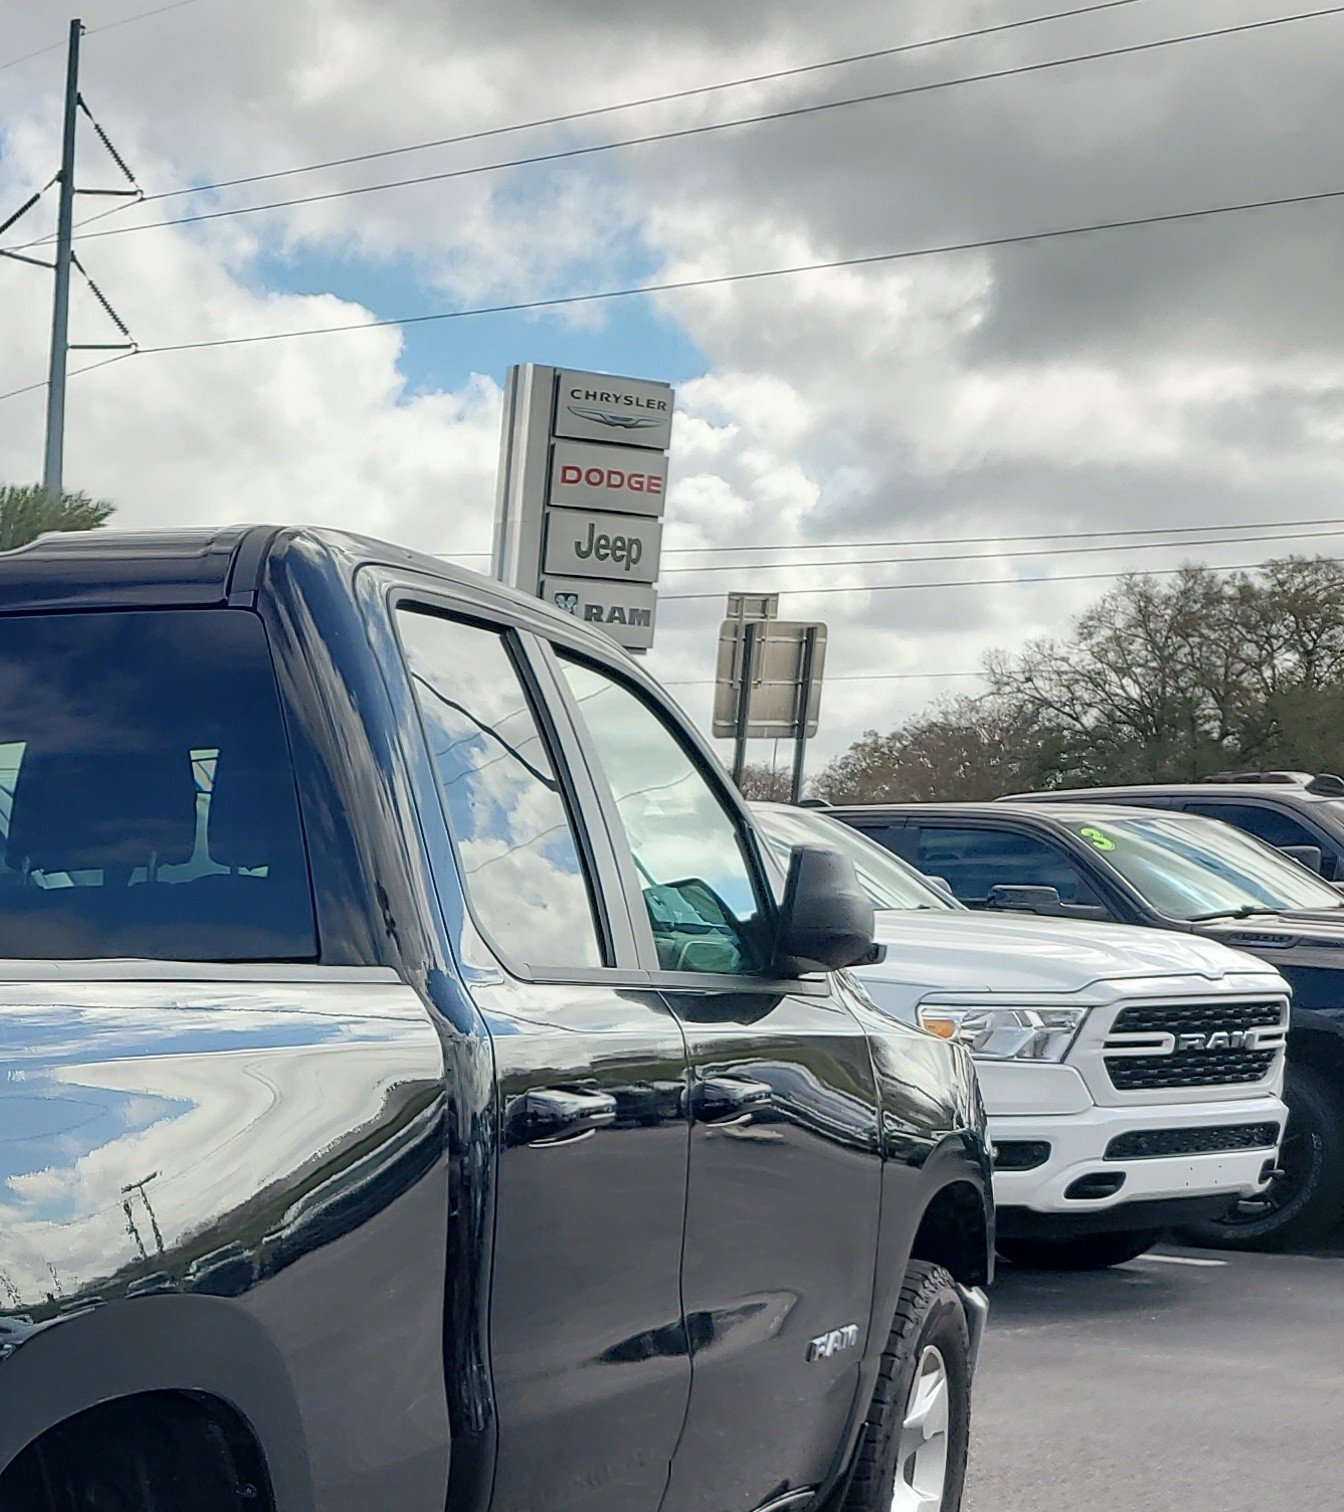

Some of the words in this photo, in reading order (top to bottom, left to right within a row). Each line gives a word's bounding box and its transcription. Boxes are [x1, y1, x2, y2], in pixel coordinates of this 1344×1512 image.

[570, 388, 667, 412] CHRYSLER
[562, 465, 663, 494] DODGE
[574, 522, 643, 571] Jeep
[583, 603, 652, 627] RAM
[1081, 827, 1116, 851] 3
[1177, 1029, 1256, 1051] RAM
[805, 1323, 860, 1363] RAM
